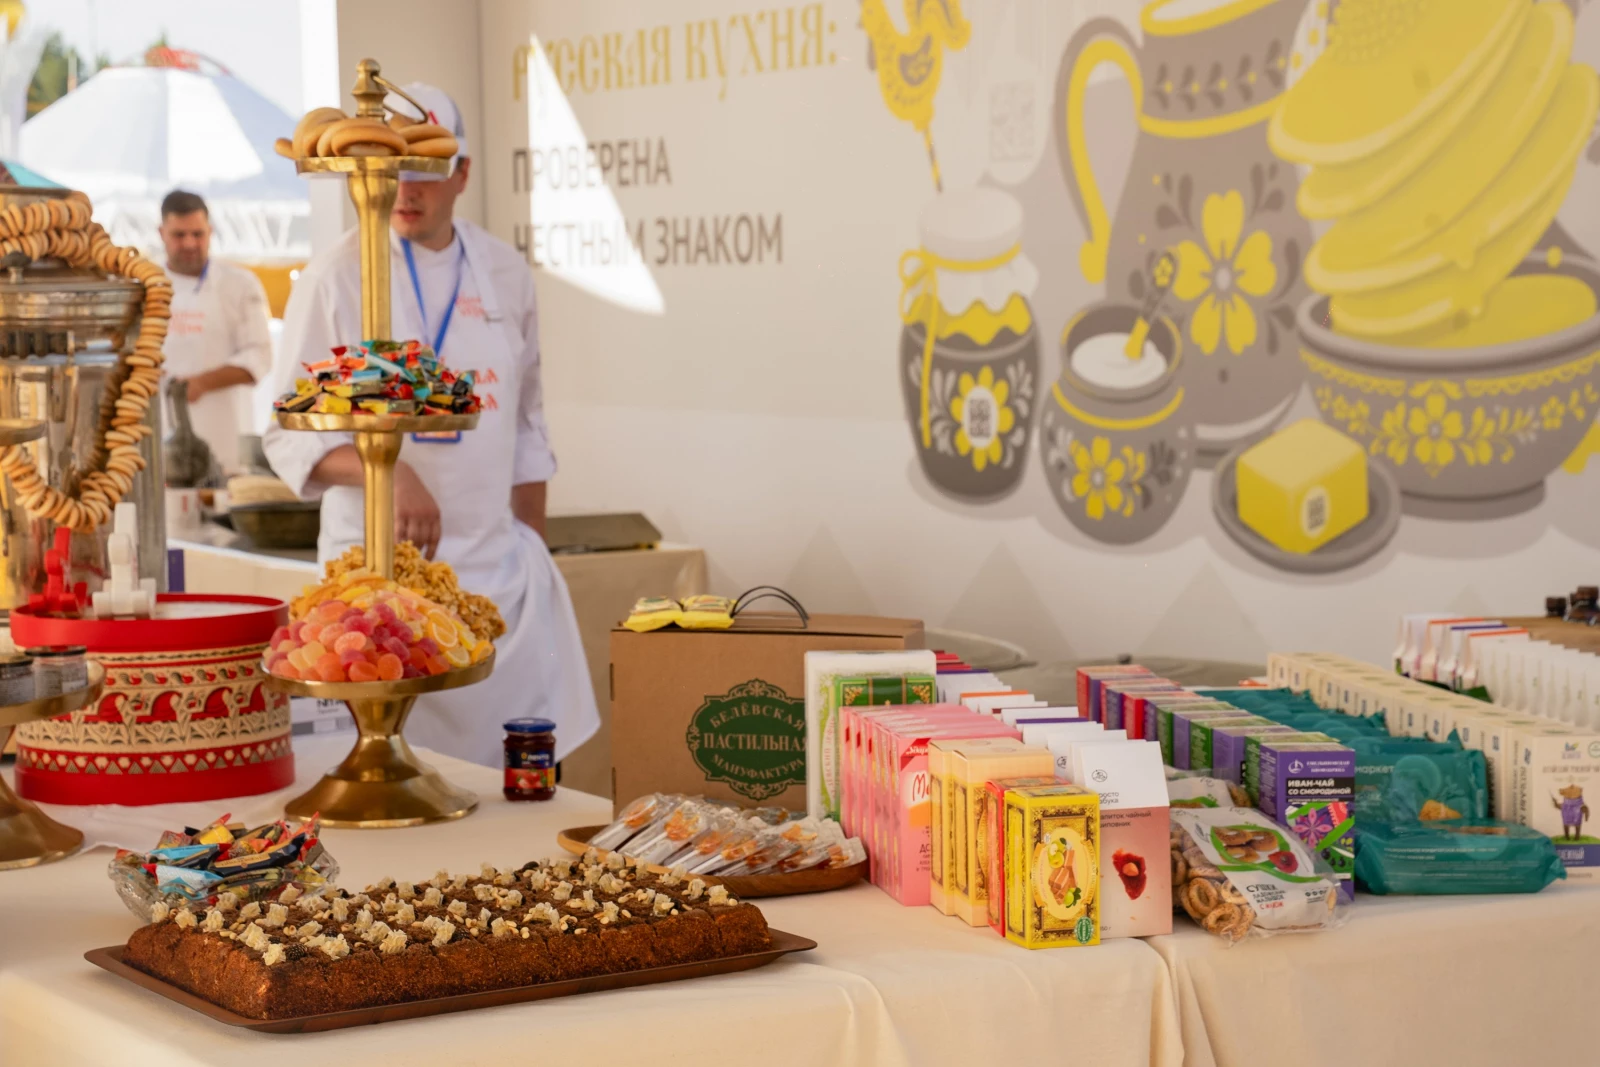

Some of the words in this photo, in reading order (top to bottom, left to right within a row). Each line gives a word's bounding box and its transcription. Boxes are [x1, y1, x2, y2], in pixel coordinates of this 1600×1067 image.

[685, 3, 837, 102] КУХНЯ:
[513, 136, 672, 193] ПРОВЕРЕНА
[655, 212, 783, 267] ЗНАКОМ
[710, 702, 805, 731] БЕЛЁВСКАЯ
[711, 754, 804, 779] МАНУФАКТУРА
[1288, 778, 1334, 787] ИВАН-ЧАЙ
[1300, 787, 1351, 795] СМОРОДИНОЙ
